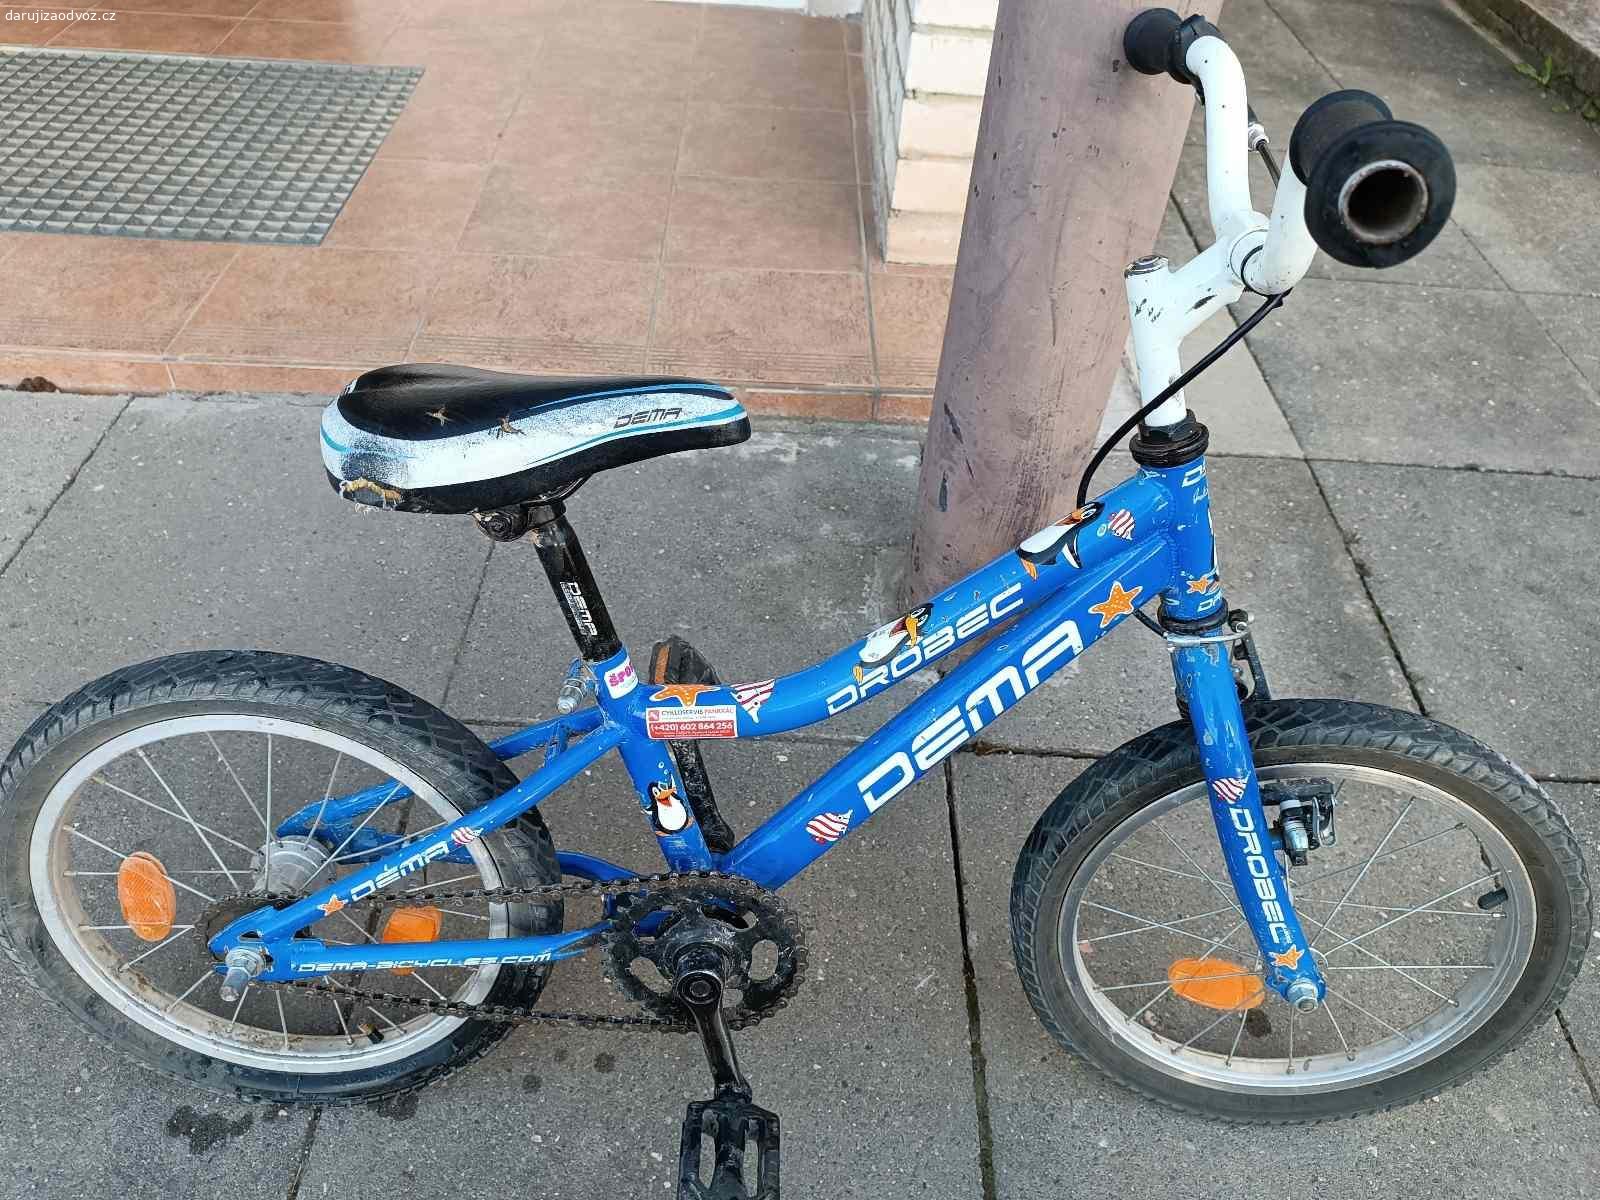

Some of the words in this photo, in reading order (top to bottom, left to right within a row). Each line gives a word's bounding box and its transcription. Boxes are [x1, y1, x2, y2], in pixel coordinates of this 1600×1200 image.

[613, 407, 683, 429] DEMA
[567, 582, 598, 636] DEMA
[825, 582, 1024, 716] DROBEC
[680, 722, 697, 731] 602
[697, 722, 715, 730] 864
[715, 721, 733, 730] 256
[857, 619, 1085, 814] DEMA
[1229, 806, 1292, 945] DROBEC
[298, 952, 551, 972] DEMA-BICYCLES.COM
